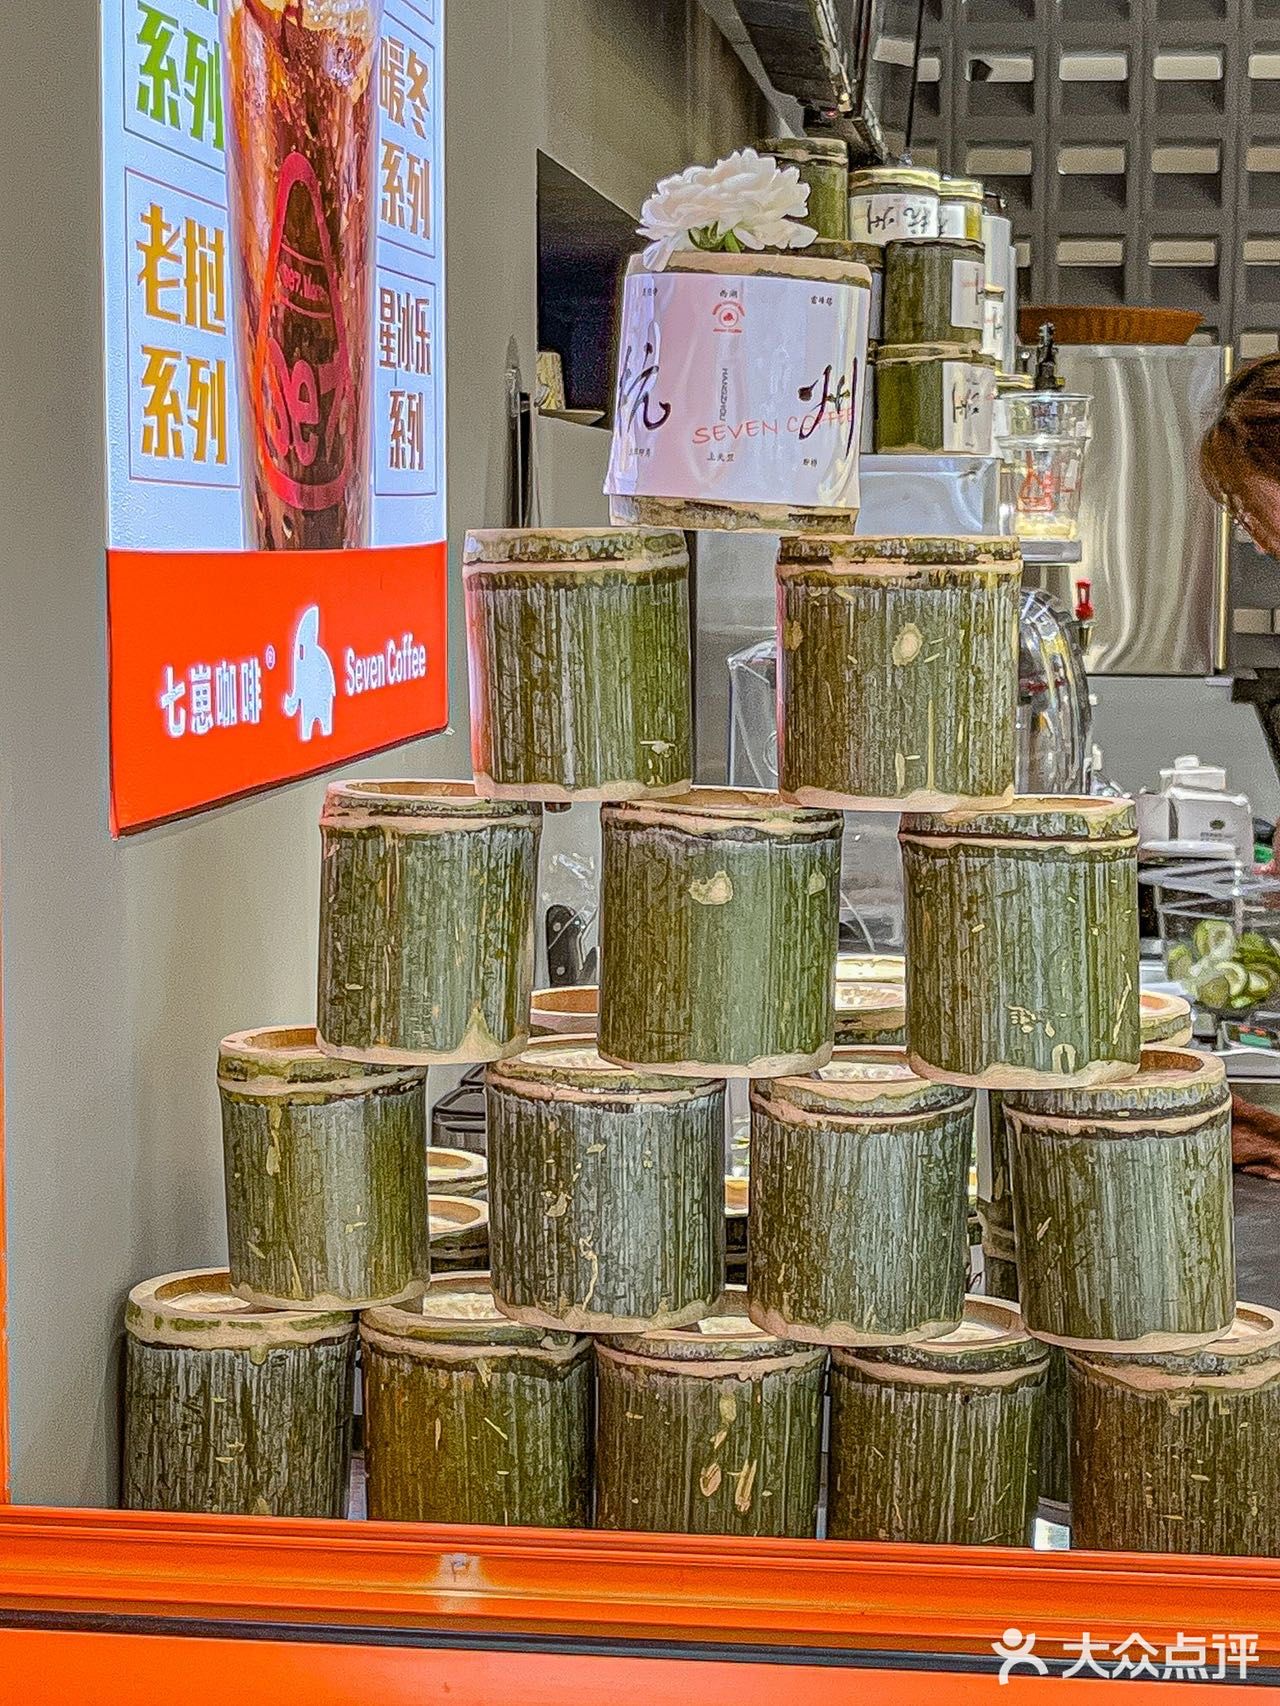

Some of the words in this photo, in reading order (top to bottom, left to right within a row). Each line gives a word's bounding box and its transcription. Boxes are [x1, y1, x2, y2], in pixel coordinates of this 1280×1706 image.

[137, 5, 225, 151] 系列
[379, 35, 430, 140] 暖冬
[380, 142, 431, 241] 系列
[136, 202, 226, 336] 老挝
[378, 286, 432, 376] 星冰乐
[140, 344, 228, 466] 系列
[389, 388, 425, 472] 系列
[691, 417, 778, 444] SEVEN
[719, 367, 729, 422] HANGZHOU
[160, 655, 263, 738] 七崽咖啡
[345, 646, 385, 696] Seven
[386, 632, 426, 684] Coffee
